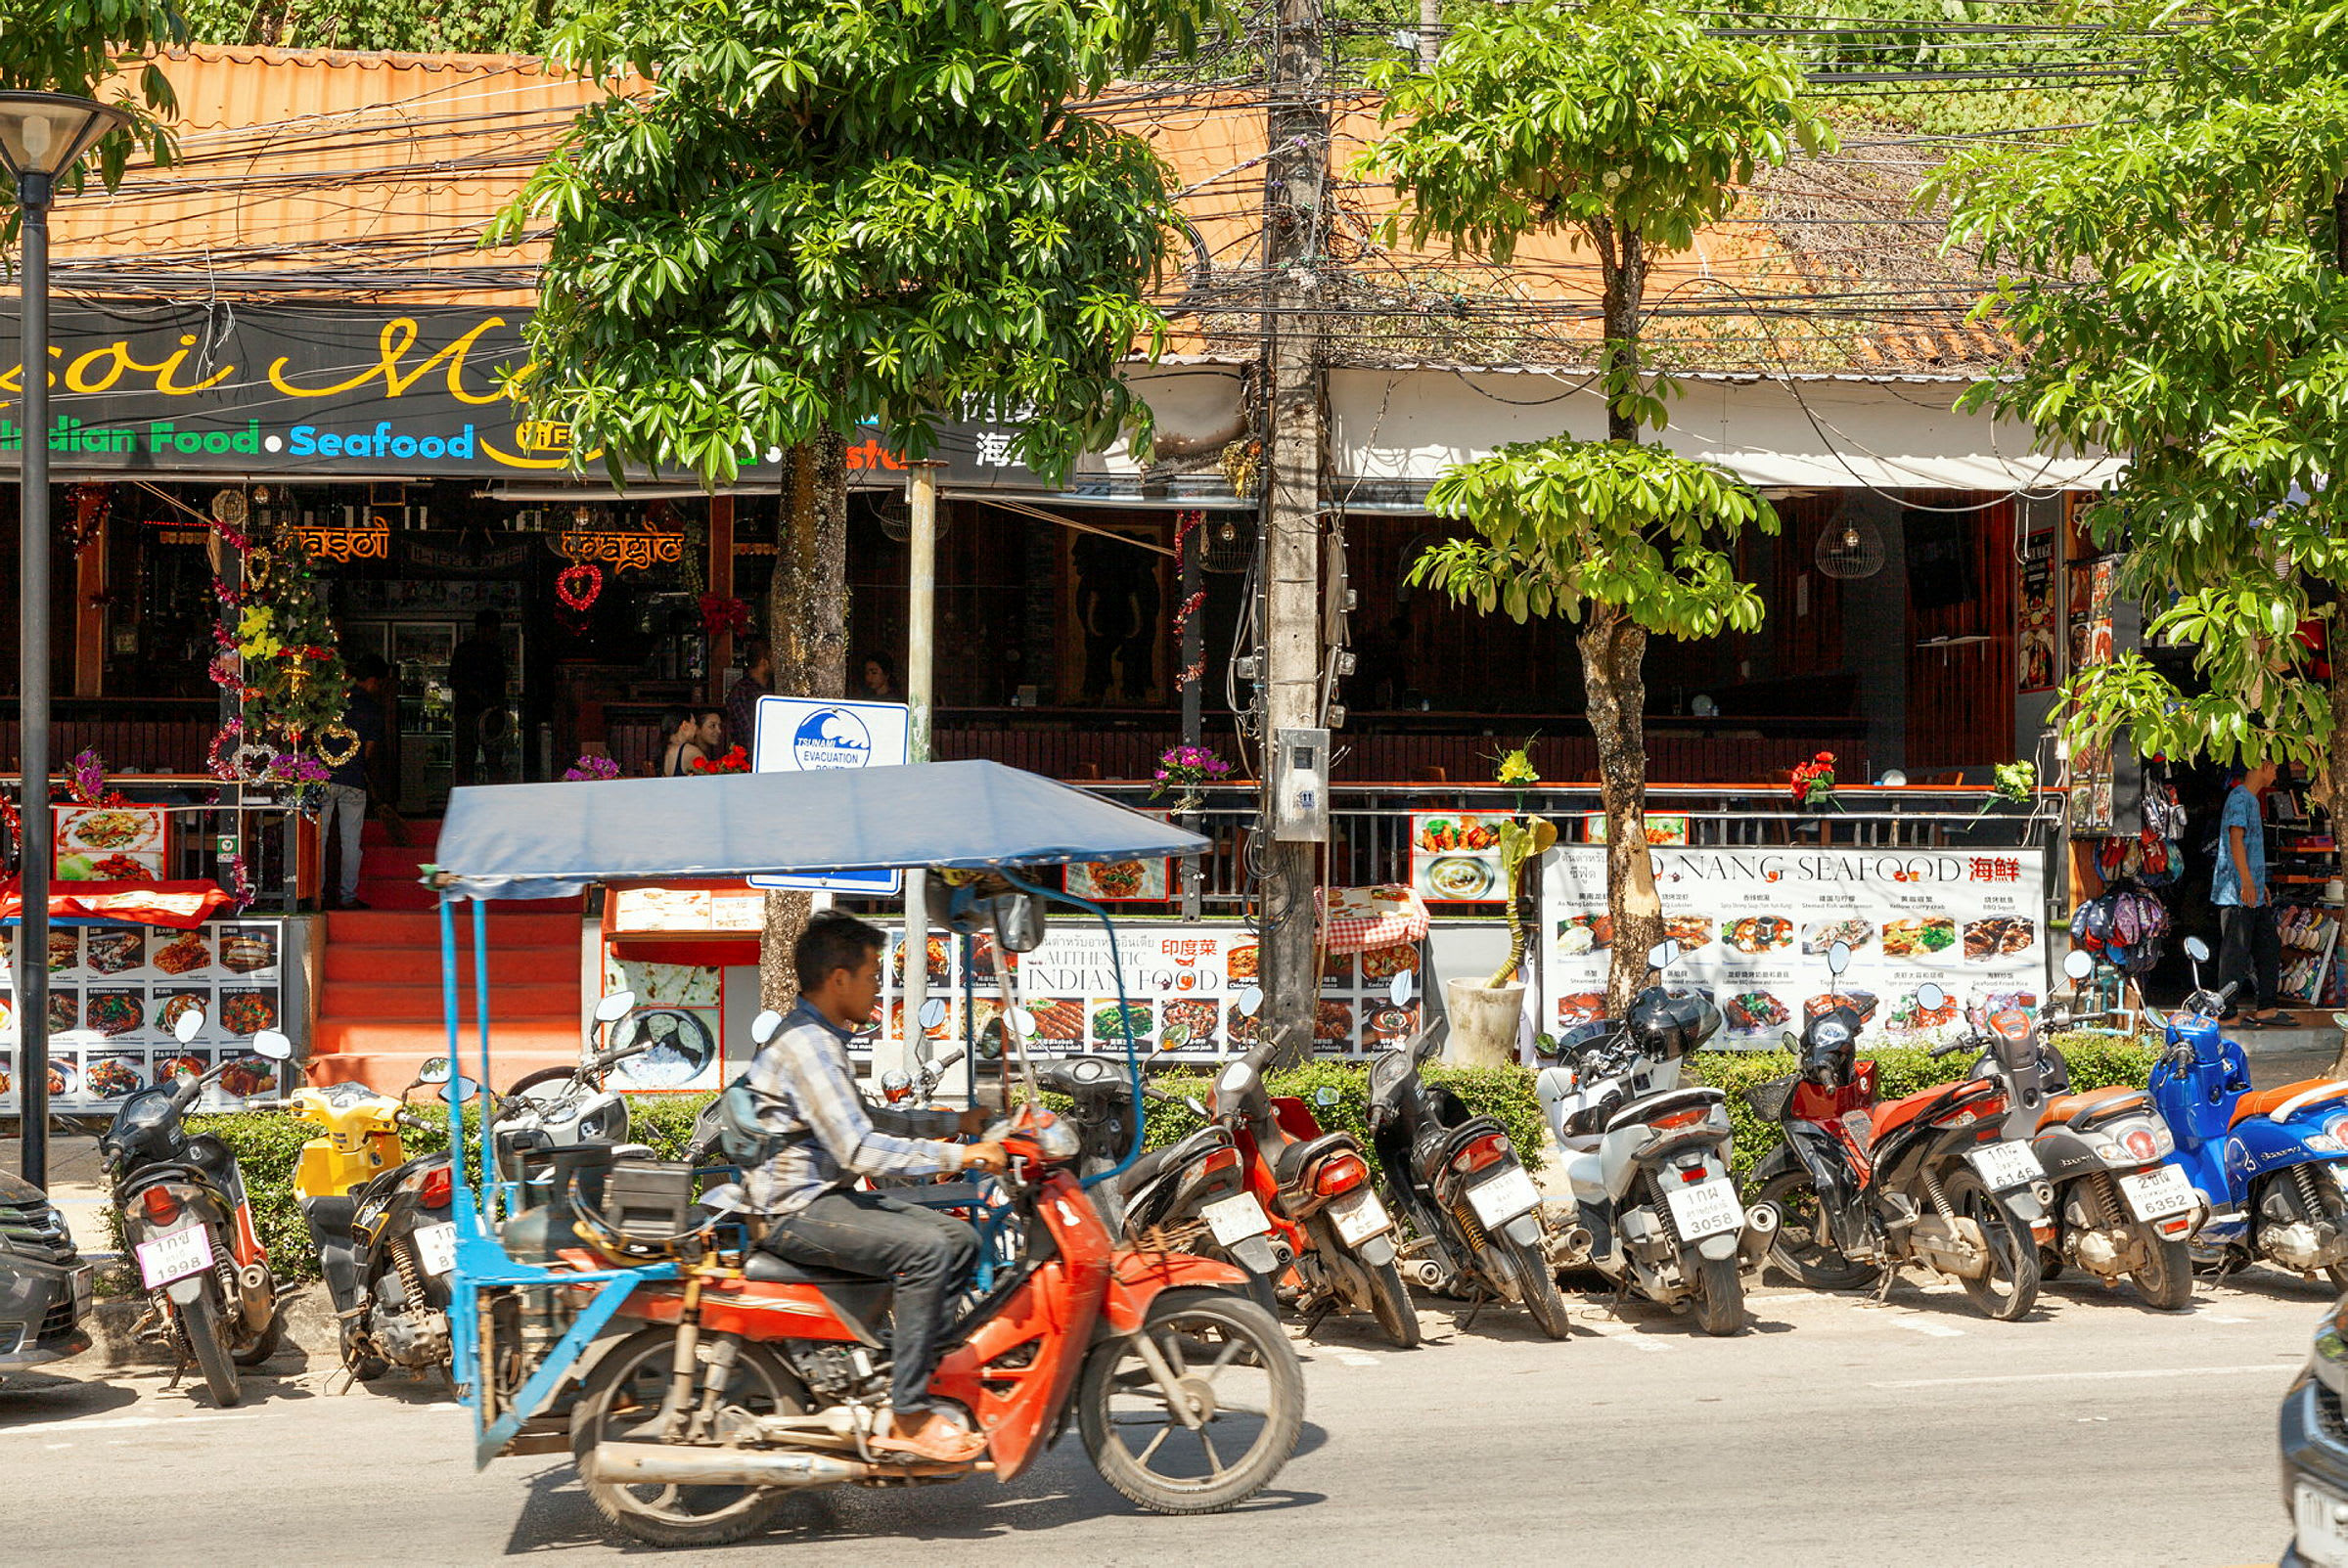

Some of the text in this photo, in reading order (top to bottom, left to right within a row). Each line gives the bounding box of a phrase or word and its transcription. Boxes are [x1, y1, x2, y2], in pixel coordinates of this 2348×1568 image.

[150, 420, 259, 456] Food
[289, 422, 474, 459] Seafood
[797, 737, 836, 748] TSUNAMI
[803, 750, 859, 764] EVACUATION
[1679, 854, 1784, 882] NANG
[1797, 855, 1962, 882] SEAFOOD
[1161, 939, 1218, 957] 印度菜
[1028, 968, 1126, 991] INDIAN
[1139, 968, 1218, 992] FOOD
[2145, 1194, 2188, 1213] 6352
[1691, 1212, 1733, 1233] 3058
[158, 1256, 202, 1280] 1998
